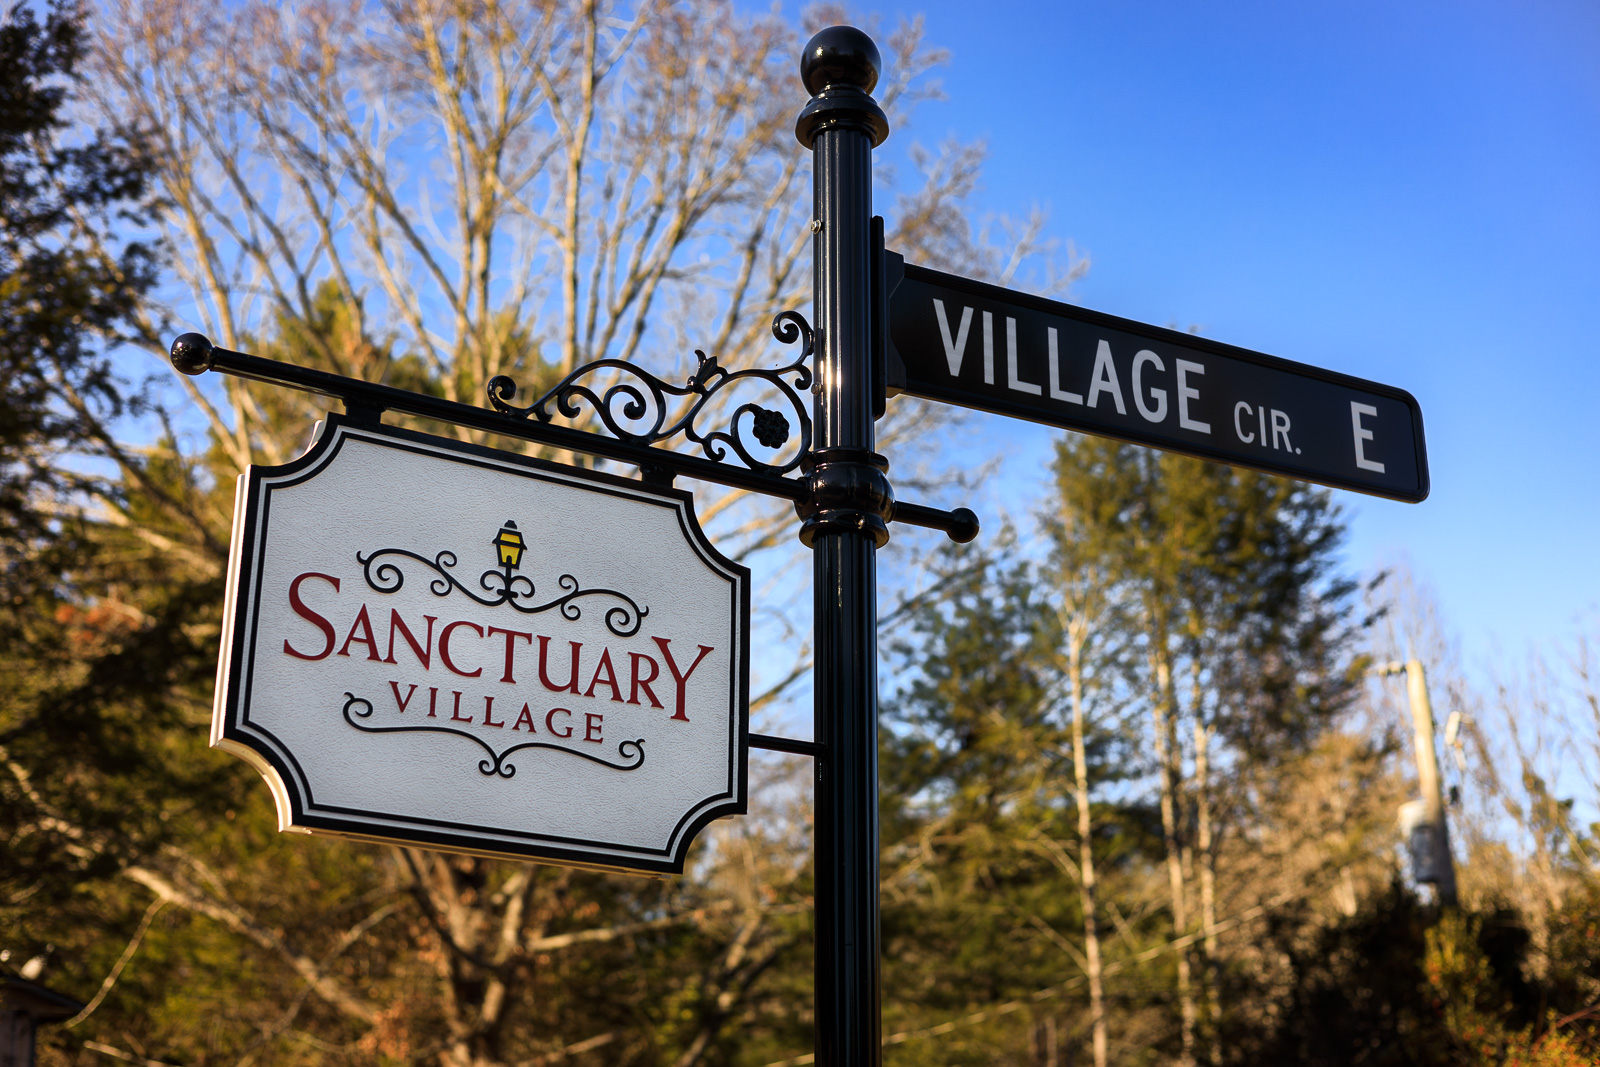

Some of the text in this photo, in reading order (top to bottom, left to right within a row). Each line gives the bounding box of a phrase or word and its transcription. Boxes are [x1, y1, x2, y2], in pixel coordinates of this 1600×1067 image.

[932, 298, 1385, 474] VILLAGE CIR. E
[283, 572, 714, 722] SANCTUARY
[388, 681, 604, 744] VILLAGE
